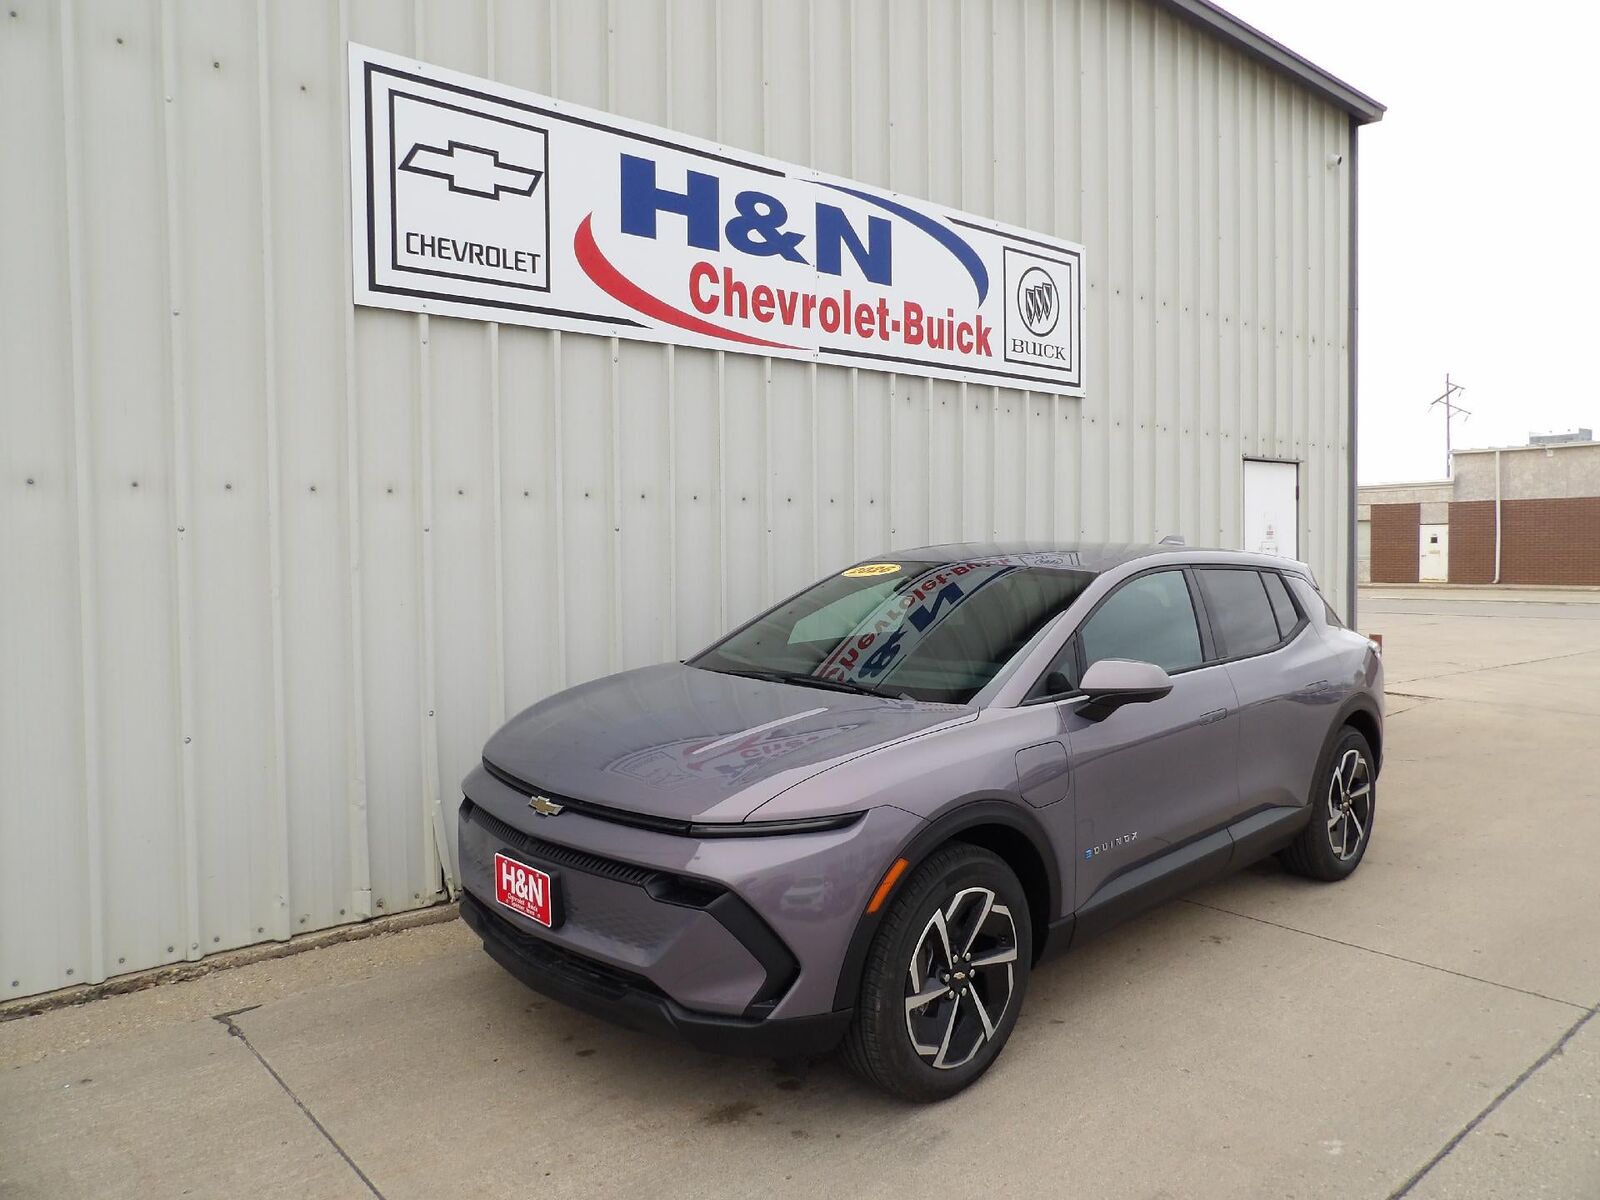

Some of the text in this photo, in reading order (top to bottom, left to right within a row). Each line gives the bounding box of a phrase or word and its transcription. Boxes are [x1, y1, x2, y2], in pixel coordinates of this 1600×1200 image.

[621, 154, 892, 287] H&N
[405, 232, 541, 275] CHEVROLET
[690, 262, 992, 357] Chevrolet-Buick
[1011, 337, 1066, 361] BUICK
[1085, 831, 1138, 859] EQUINOX
[502, 862, 543, 908] H&N
